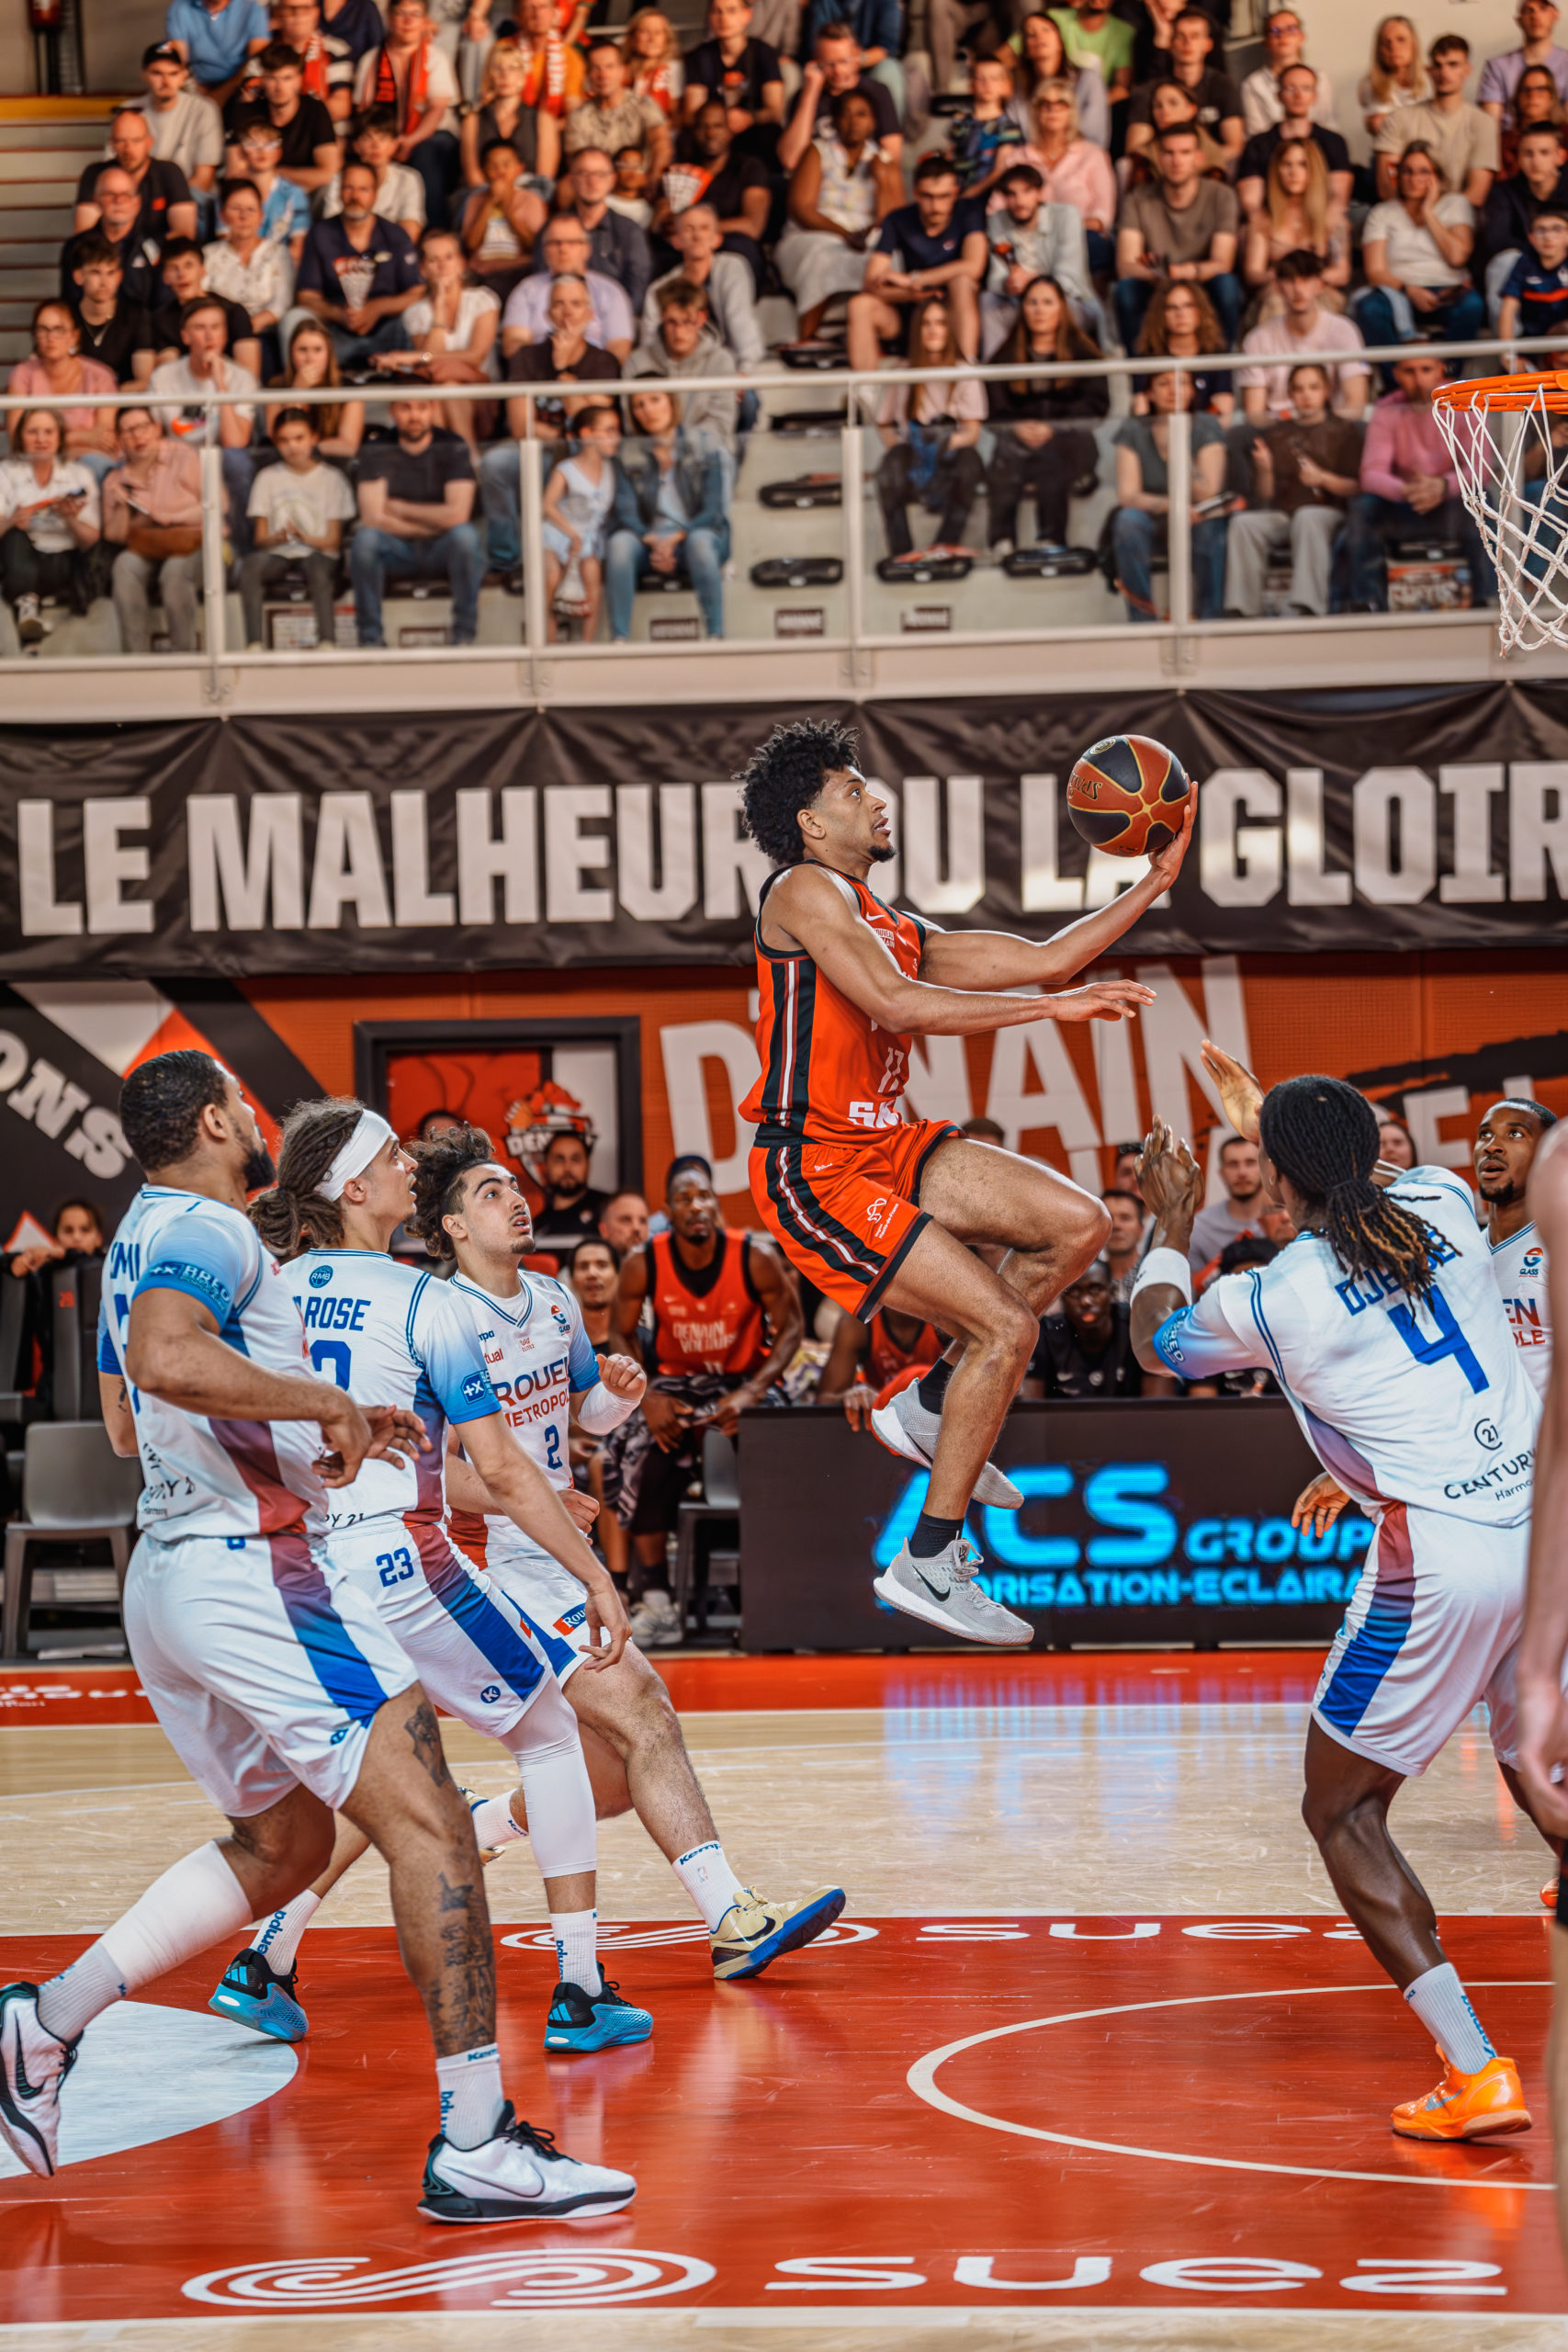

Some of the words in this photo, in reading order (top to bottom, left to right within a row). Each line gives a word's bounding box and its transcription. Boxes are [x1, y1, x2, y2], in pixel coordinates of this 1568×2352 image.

[17, 796, 154, 936] LE
[186, 781, 773, 933] MALHEUR
[1386, 1283, 1490, 1395] 4
[544, 1424, 563, 1470] 2
[375, 1546, 414, 1588] 23
[763, 2256, 1508, 2296] suez
